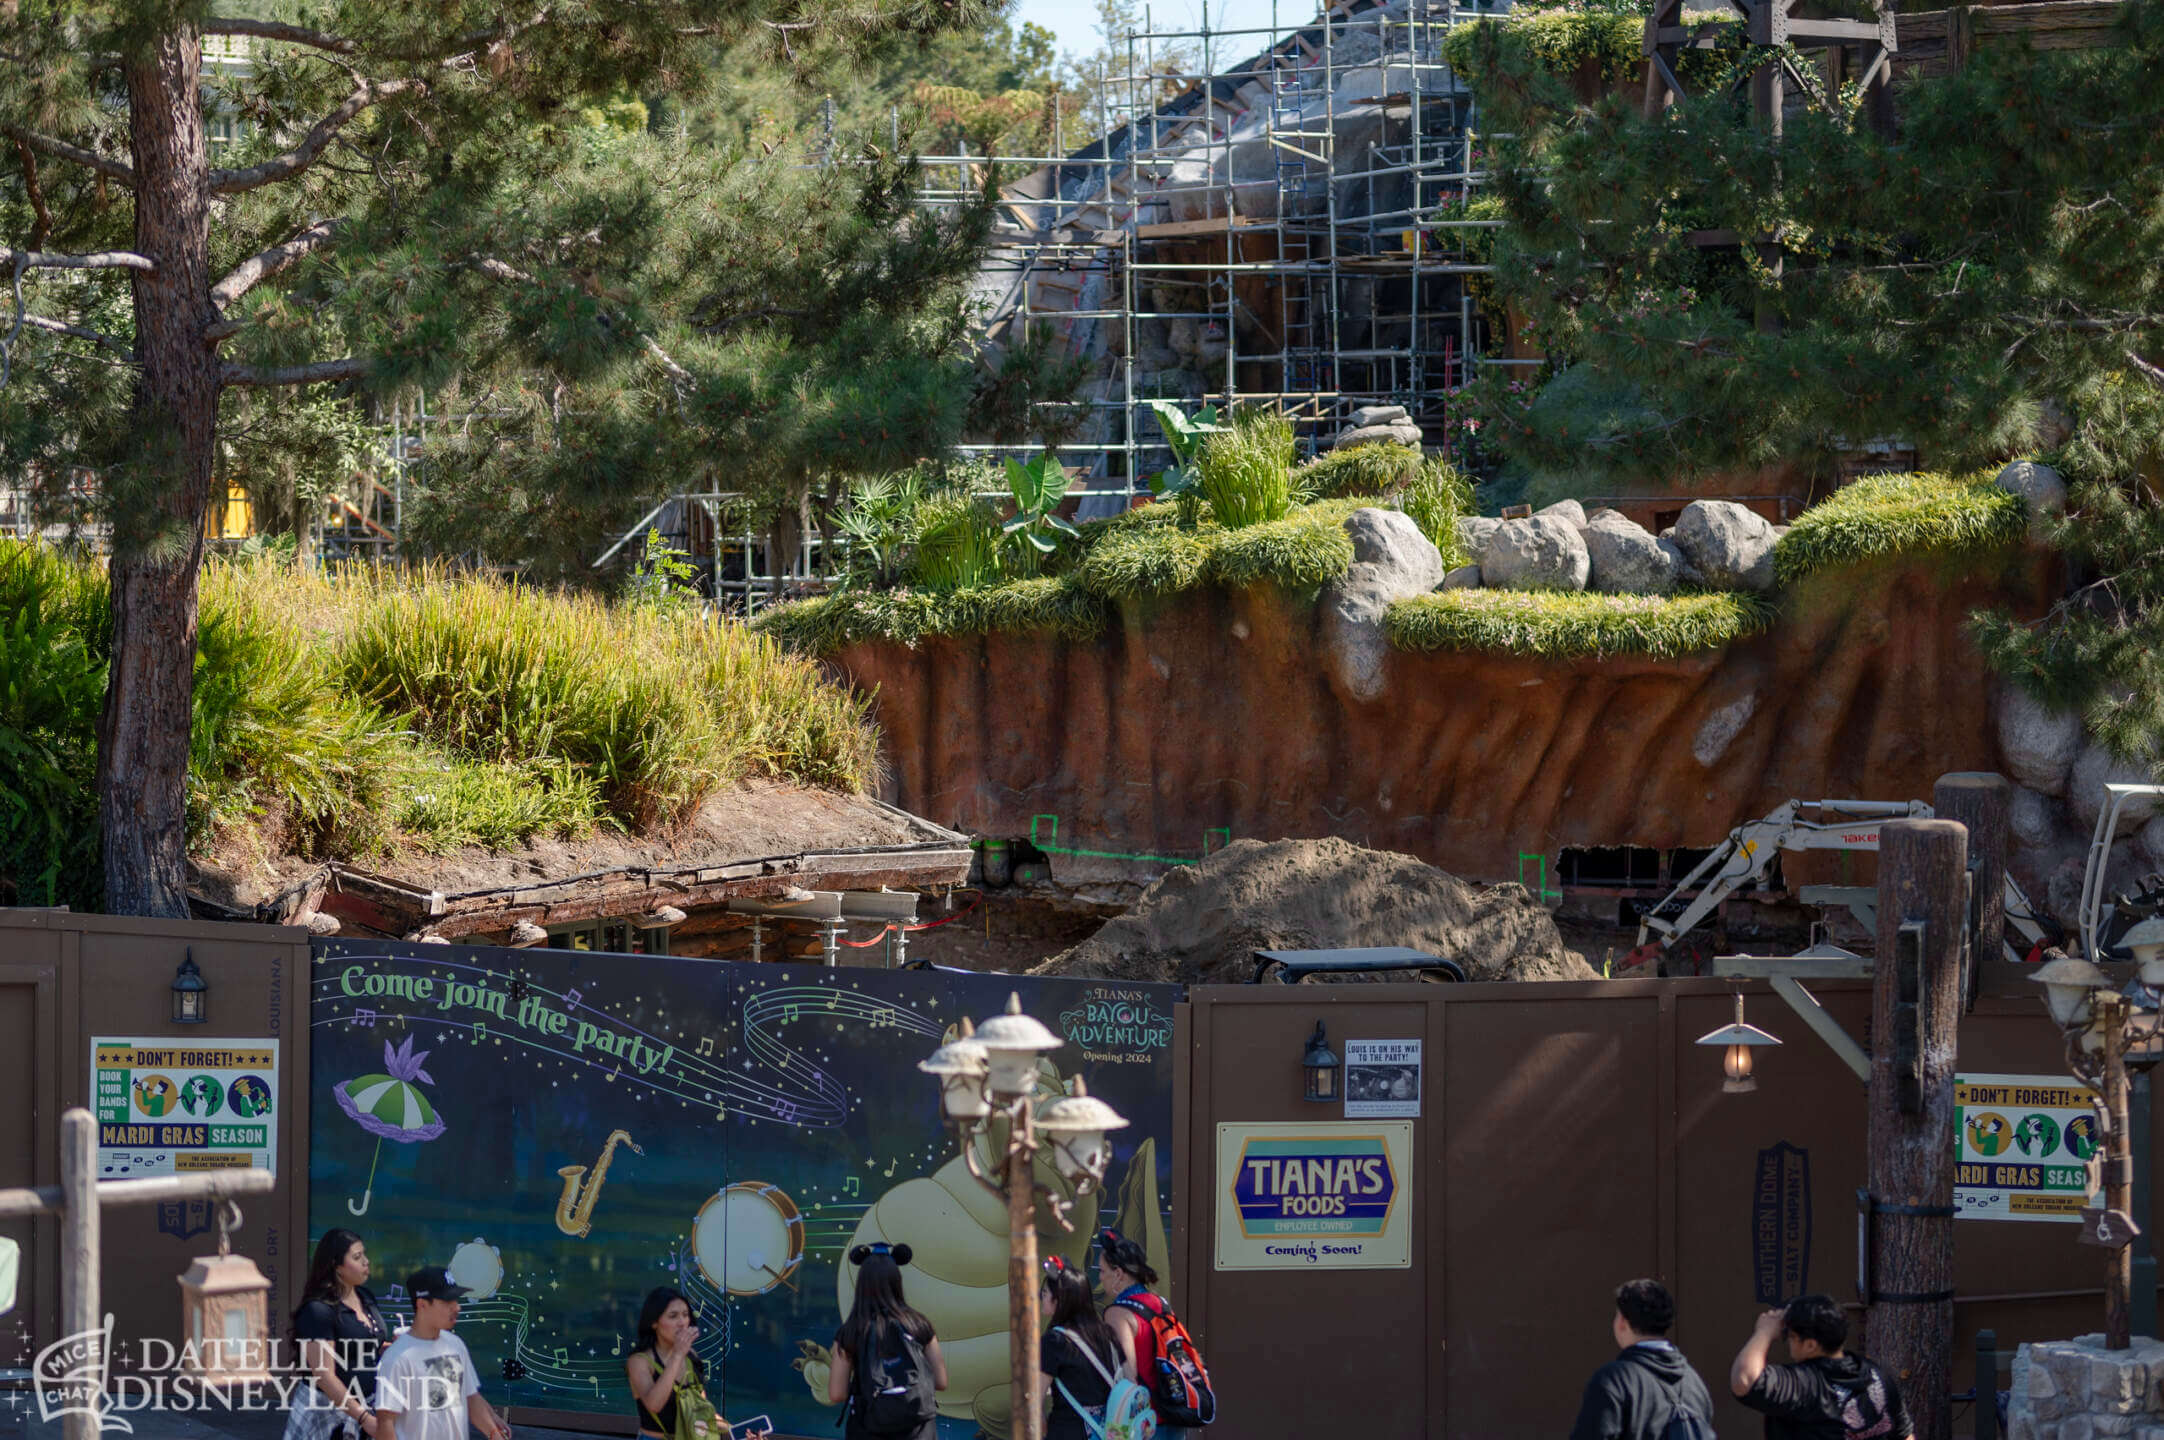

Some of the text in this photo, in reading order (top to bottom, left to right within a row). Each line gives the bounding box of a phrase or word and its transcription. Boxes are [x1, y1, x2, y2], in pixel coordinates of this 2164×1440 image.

[271, 957, 280, 1039] LOUISIANA
[1093, 987, 1143, 1001] TIANA'S
[341, 966, 674, 1075] Come join the party!
[1087, 1001, 1148, 1025] BAYOU
[1069, 1022, 1168, 1053] ADVENTURE
[137, 1051, 233, 1067] DON'T FORGET!
[1083, 1051, 1152, 1064] Opening 2024
[1347, 1045, 1367, 1054] LOUIS
[1404, 1045, 1419, 1053] WAY
[1359, 1054, 1368, 1062] TO
[1384, 1053, 1409, 1062] PARTY!
[99, 1071, 122, 1082] BOOK
[99, 1084, 122, 1095] YOUR
[1970, 1087, 2070, 1106] DON'T FORGET!
[99, 1096, 128, 1108] BANDS
[99, 1109, 116, 1121] FOR
[103, 1126, 263, 1145] MARDI GRAS SEASON
[1247, 1158, 1384, 1196] TIANA'S
[1996, 1167, 2040, 1187] GRAS
[1282, 1196, 1346, 1216] FOODS
[1274, 1221, 1353, 1232] EMPLOYEE OWNED
[1760, 1151, 1777, 1297] SOUTHERN DOME
[1786, 1167, 1800, 1282] SALT COMPANY
[267, 1226, 279, 1256] DRY
[1265, 1240, 1363, 1264] Coming Soon!
